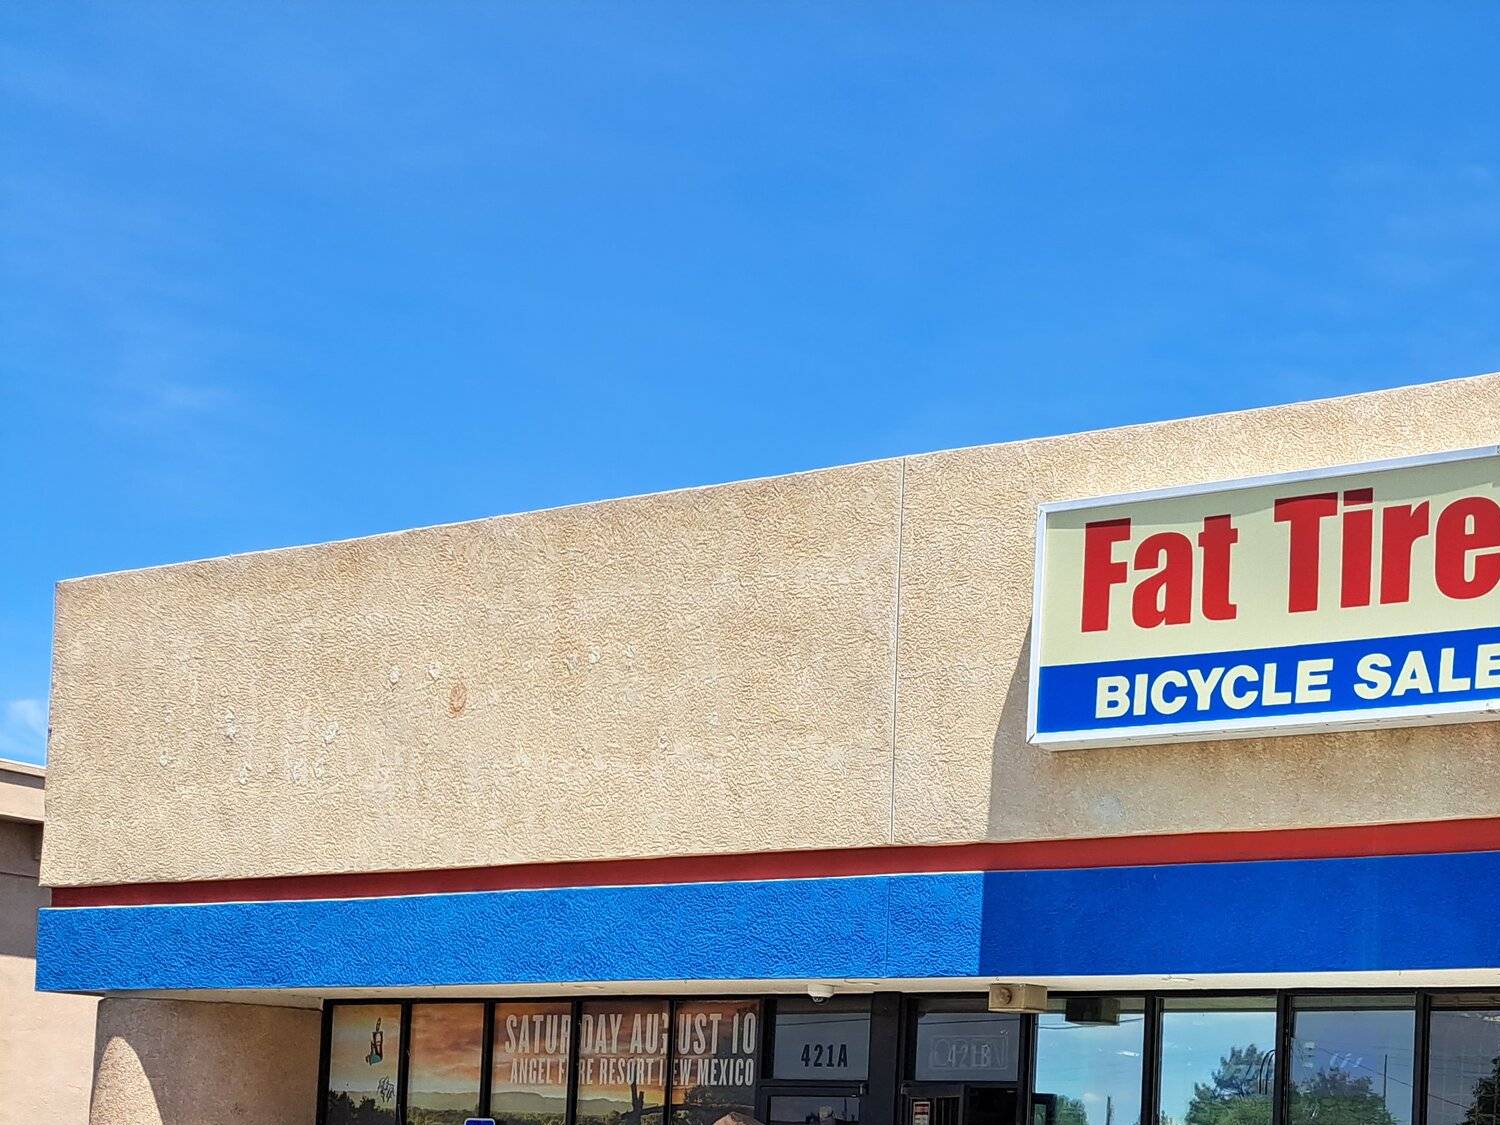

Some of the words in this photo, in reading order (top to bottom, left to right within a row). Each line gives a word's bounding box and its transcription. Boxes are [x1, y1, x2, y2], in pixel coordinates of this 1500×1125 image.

[1080, 515, 1239, 634] Fat
[1094, 658, 1335, 719] BICYCLE
[505, 1013, 623, 1054] SATURDAY
[732, 1012, 757, 1054] 10
[510, 1058, 553, 1084] ANGEL
[558, 1058, 594, 1085] FRE
[599, 1058, 655, 1086] RESORT
[698, 1058, 755, 1086] MEXICO
[800, 1043, 848, 1068] 421A
